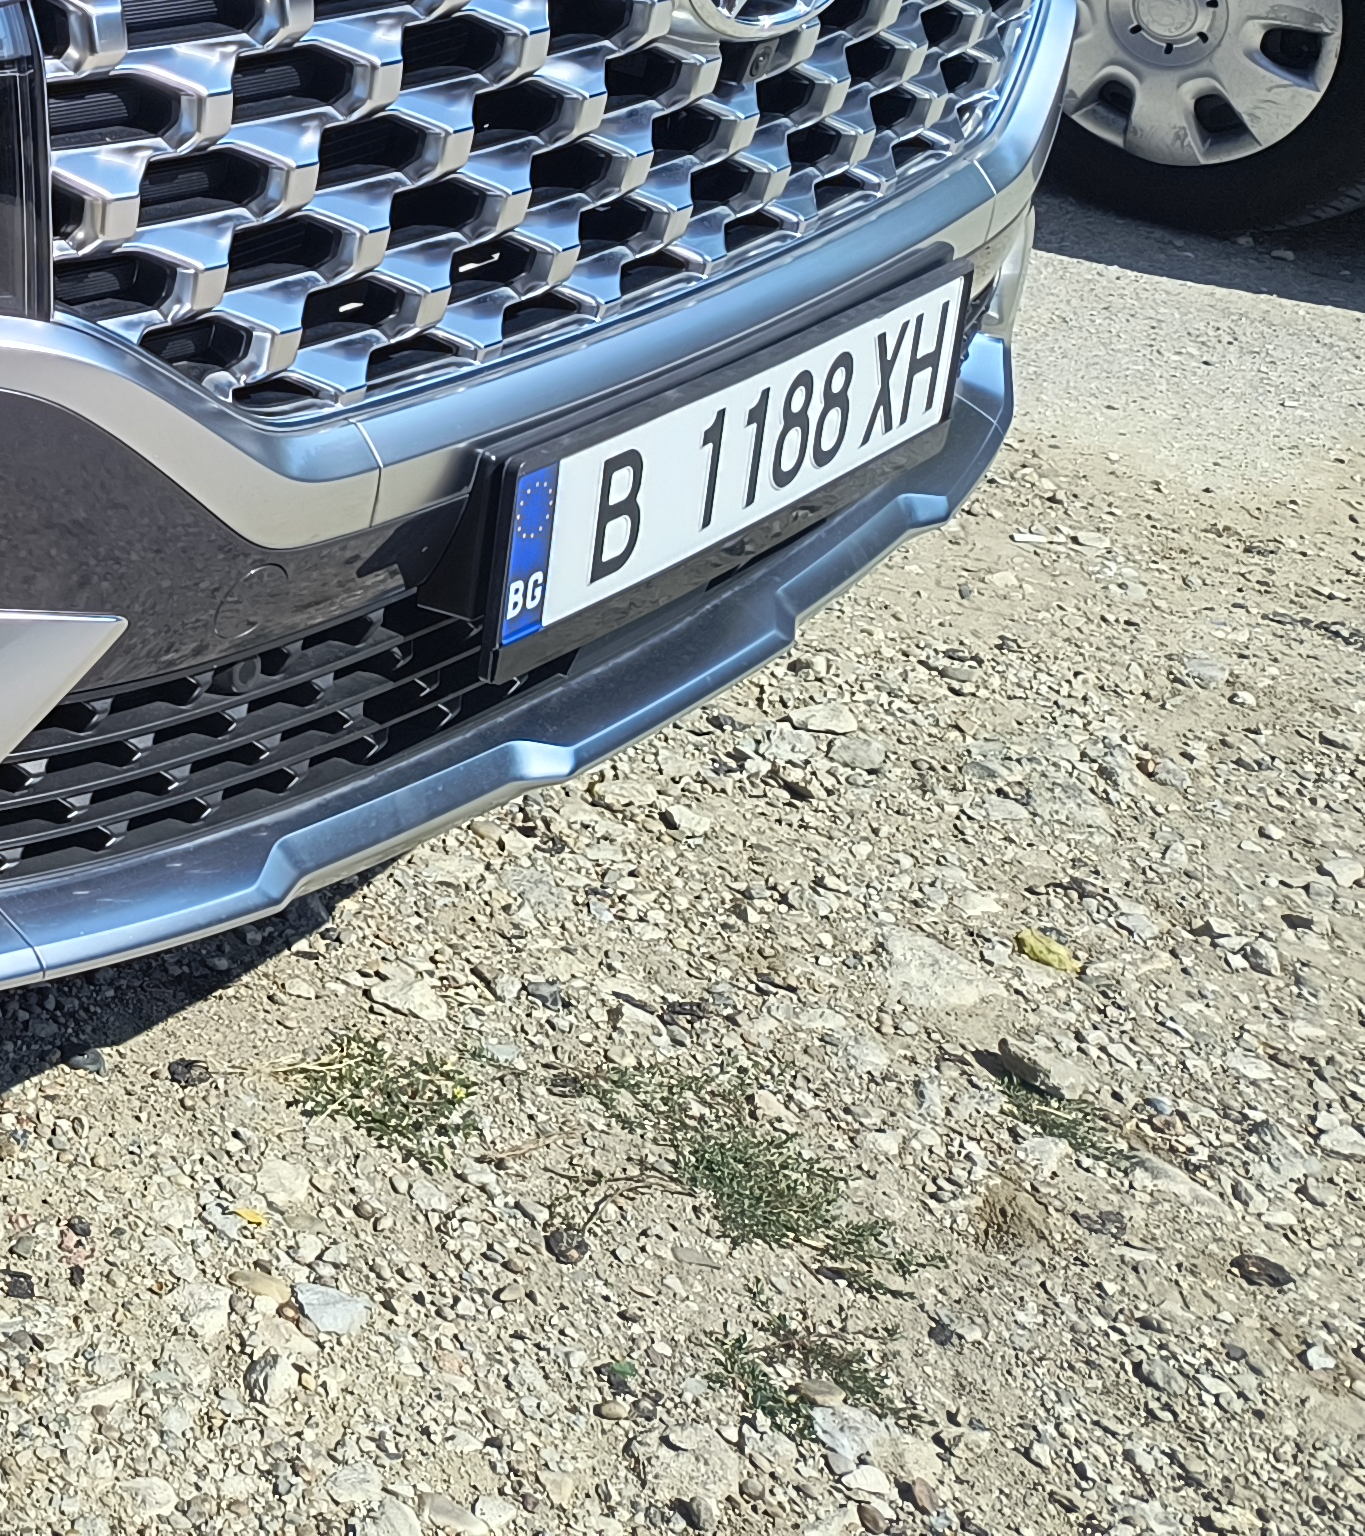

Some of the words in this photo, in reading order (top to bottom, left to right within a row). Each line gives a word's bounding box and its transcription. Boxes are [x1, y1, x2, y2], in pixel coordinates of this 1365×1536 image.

[588, 448, 643, 586] B
[700, 350, 854, 531] 1188
[859, 299, 951, 449] XH
[506, 570, 544, 621] BG
